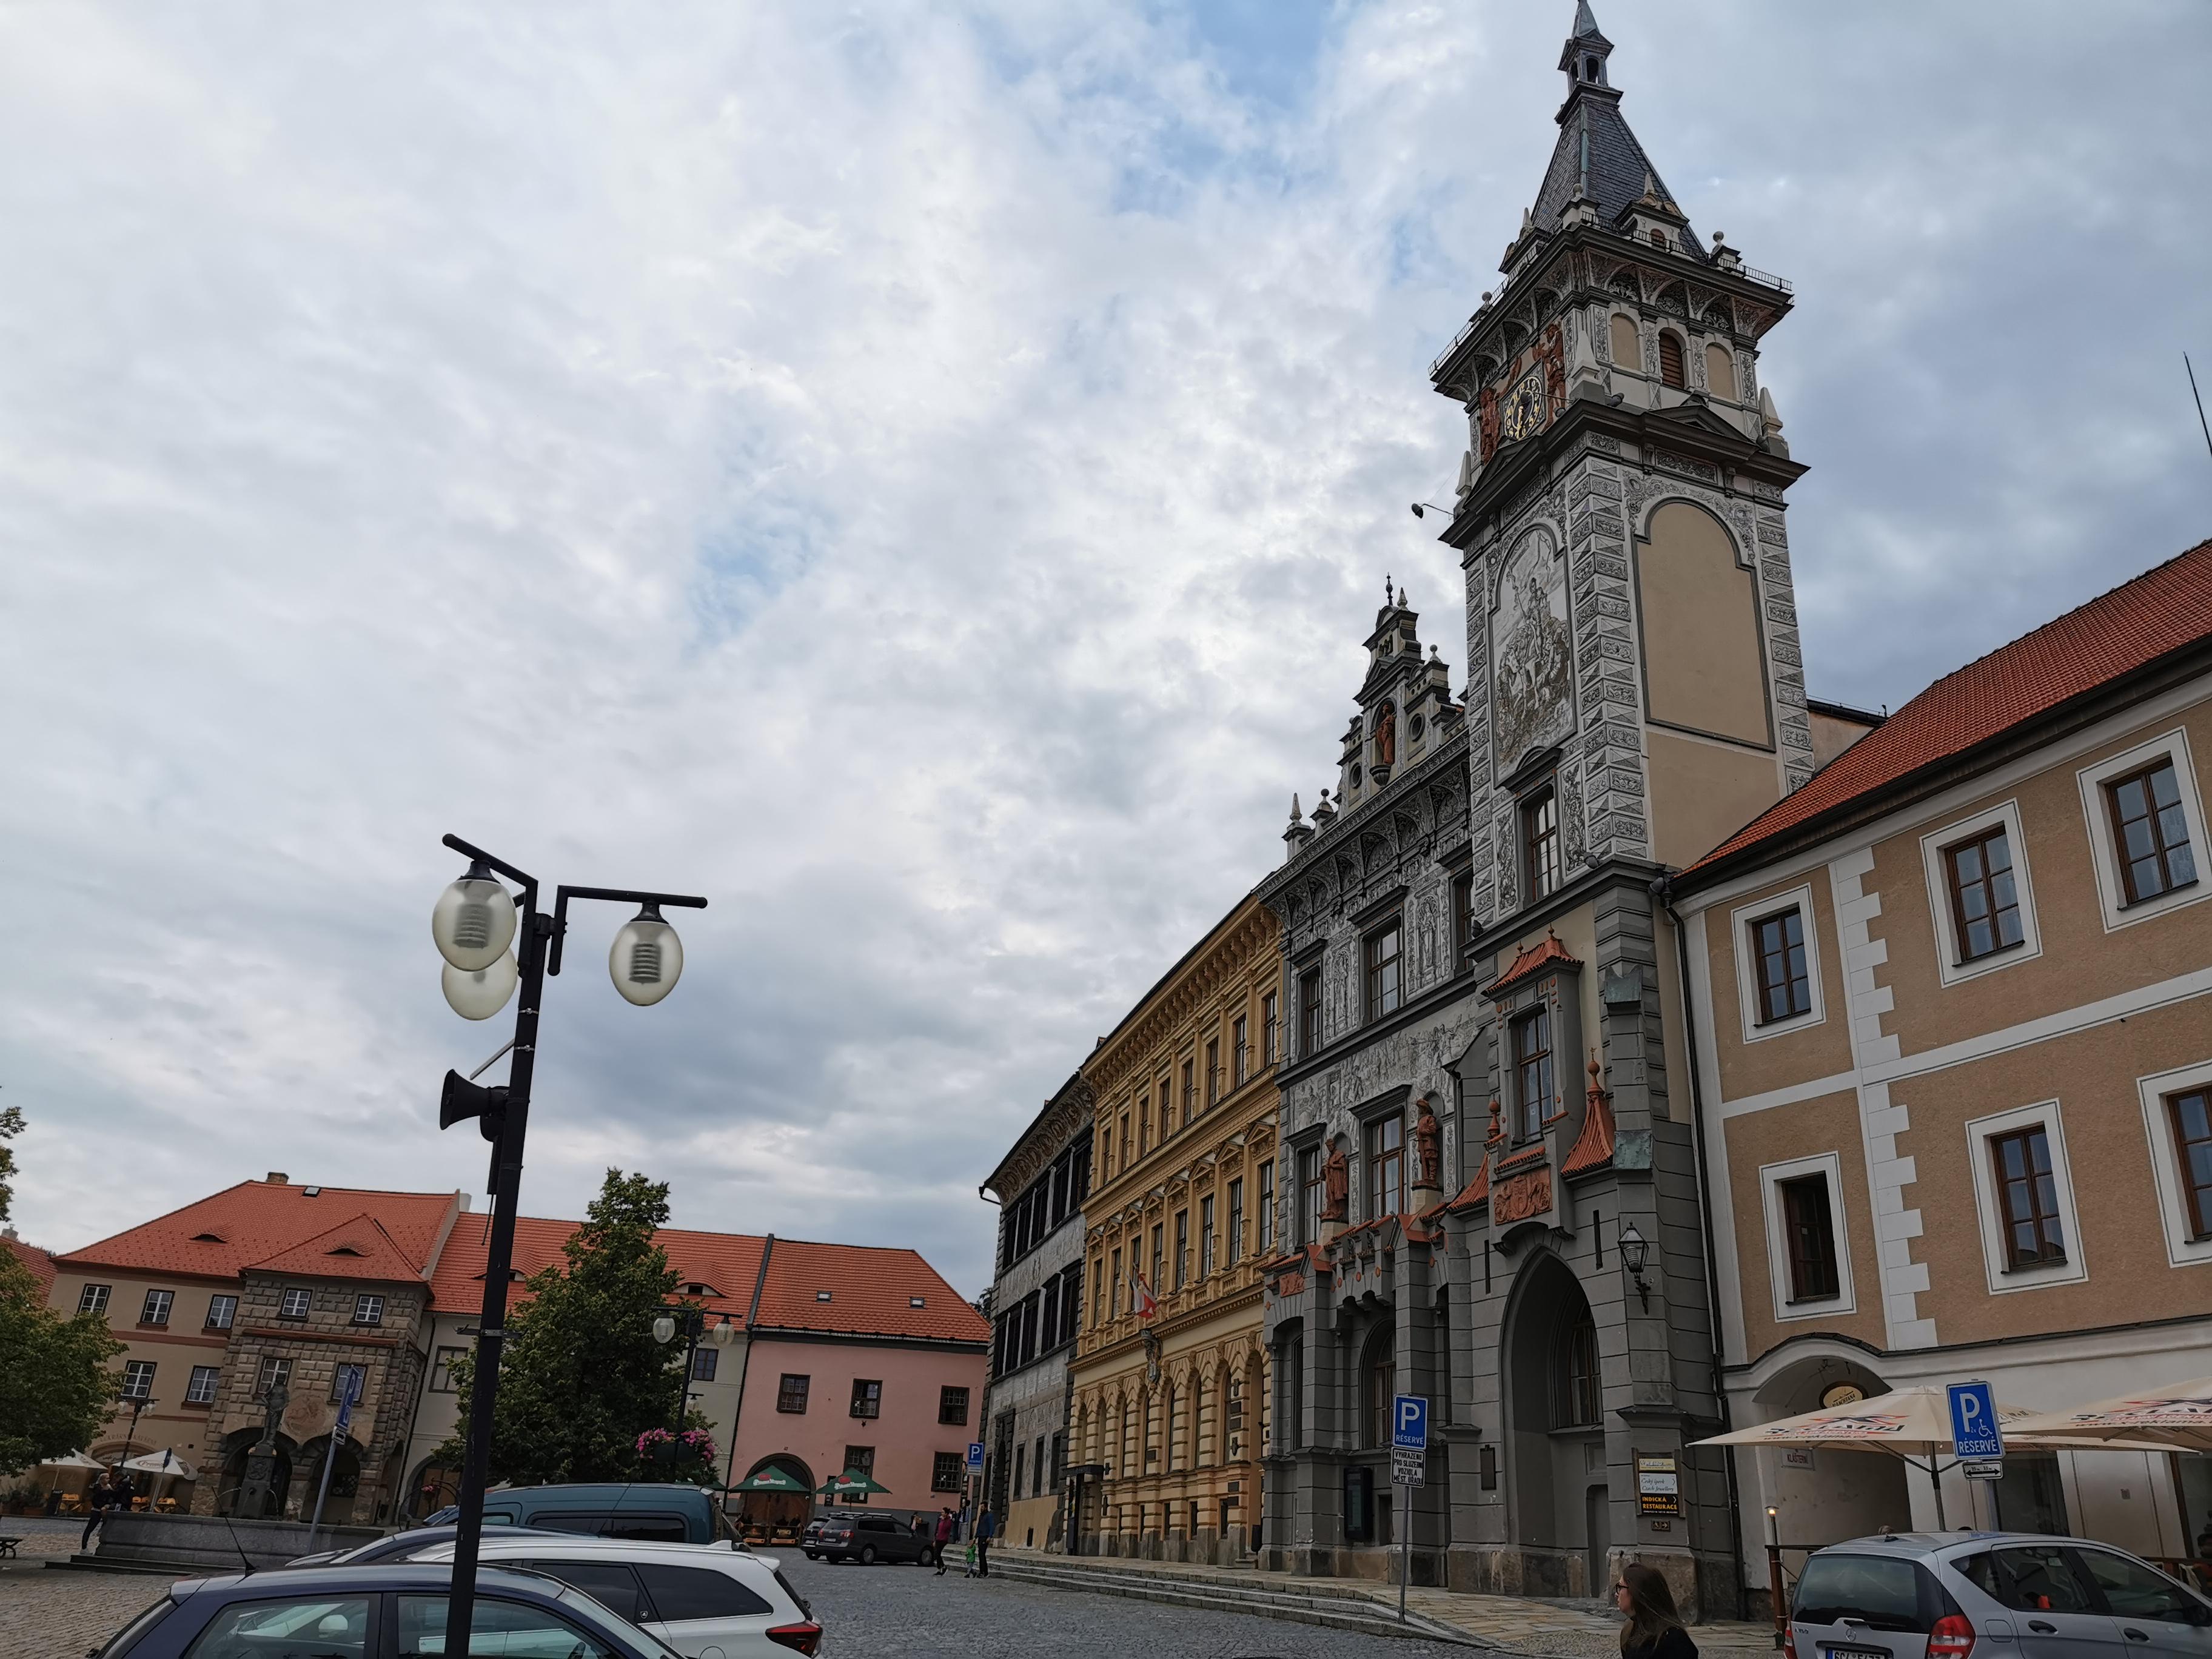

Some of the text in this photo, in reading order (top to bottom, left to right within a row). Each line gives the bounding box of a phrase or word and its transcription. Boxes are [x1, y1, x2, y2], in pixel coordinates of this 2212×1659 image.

[1401, 1401, 1420, 1431] P
[1959, 1393, 1980, 1433] P
[1396, 1433, 1424, 1445] RÉSERVÉ
[1958, 1436, 1998, 1453] RÉSERVÉ
[971, 1446, 980, 1459] P
